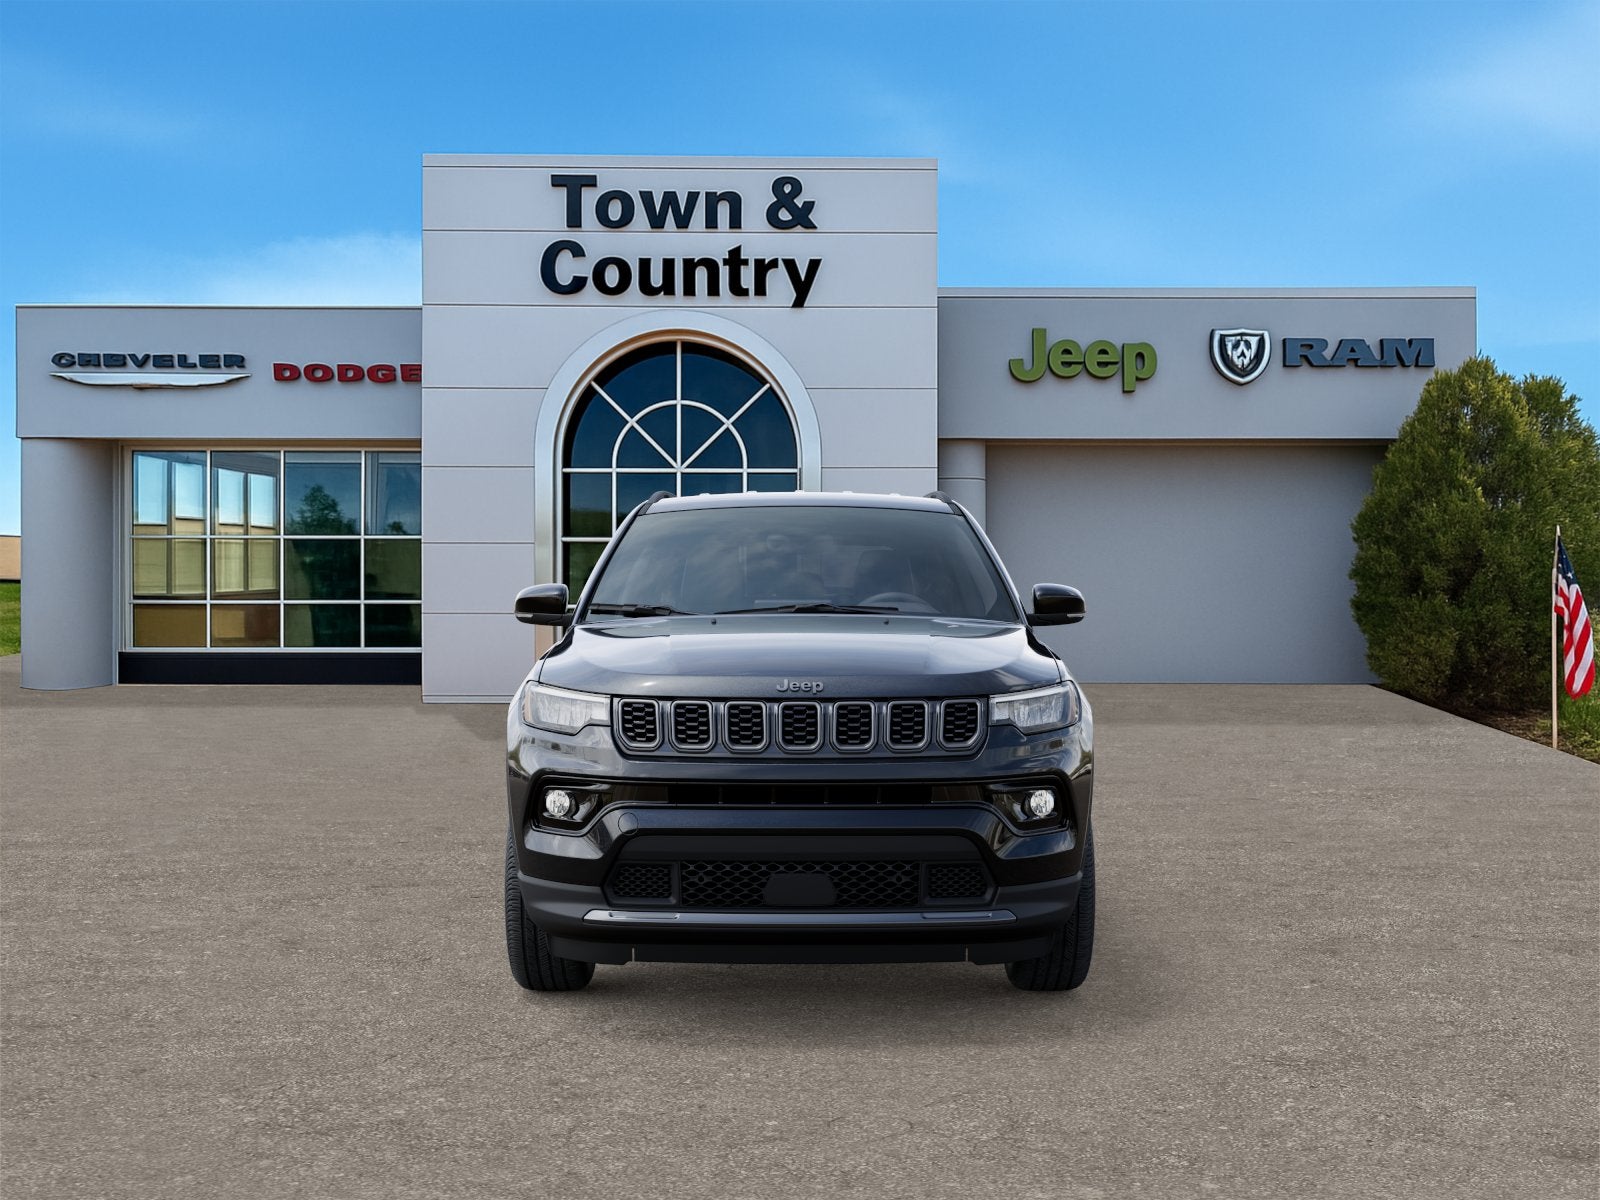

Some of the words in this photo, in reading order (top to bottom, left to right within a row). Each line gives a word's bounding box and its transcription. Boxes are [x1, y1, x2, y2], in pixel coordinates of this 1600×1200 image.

[551, 174, 742, 229] Town
[765, 175, 818, 229] &
[540, 240, 822, 308] Country
[273, 363, 422, 383] DODGE
[1008, 328, 1157, 393] Jeep
[1283, 337, 1435, 368] RAM
[776, 679, 824, 694] Jeep
